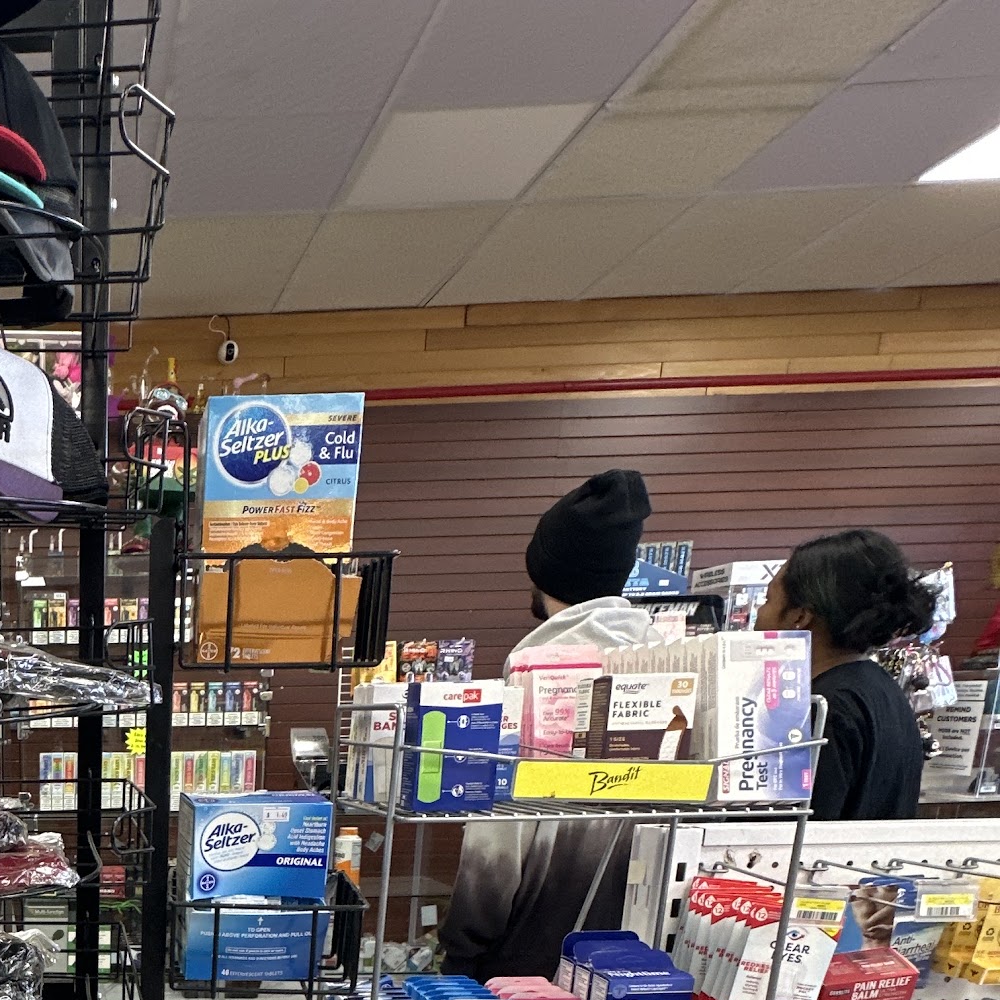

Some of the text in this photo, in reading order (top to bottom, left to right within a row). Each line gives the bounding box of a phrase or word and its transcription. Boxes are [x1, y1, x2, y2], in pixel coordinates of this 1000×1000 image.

[224, 417, 274, 439] Alka-
[219, 430, 285, 458] Seltzer
[325, 431, 356, 445] Cold
[253, 445, 290, 464] PLUS
[319, 446, 354, 460] & Flu
[616, 683, 648, 692] equate
[443, 691, 480, 703] carepak
[613, 700, 661, 709] FLEXIBLE
[612, 710, 650, 718] FABRIC
[937, 715, 977, 723] CUSTOMERS
[739, 697, 758, 792] Pregnancy
[588, 766, 643, 796] Bandit
[756, 762, 768, 791] Test
[207, 823, 248, 840] Alka-
[204, 832, 256, 852] Seltzer
[276, 856, 324, 868] ORIGINAL
[770, 940, 810, 955] CEAR
[892, 936, 916, 946] Anti-
[853, 976, 912, 992] PAIN RELIEF
[851, 989, 879, 1000] BALM
